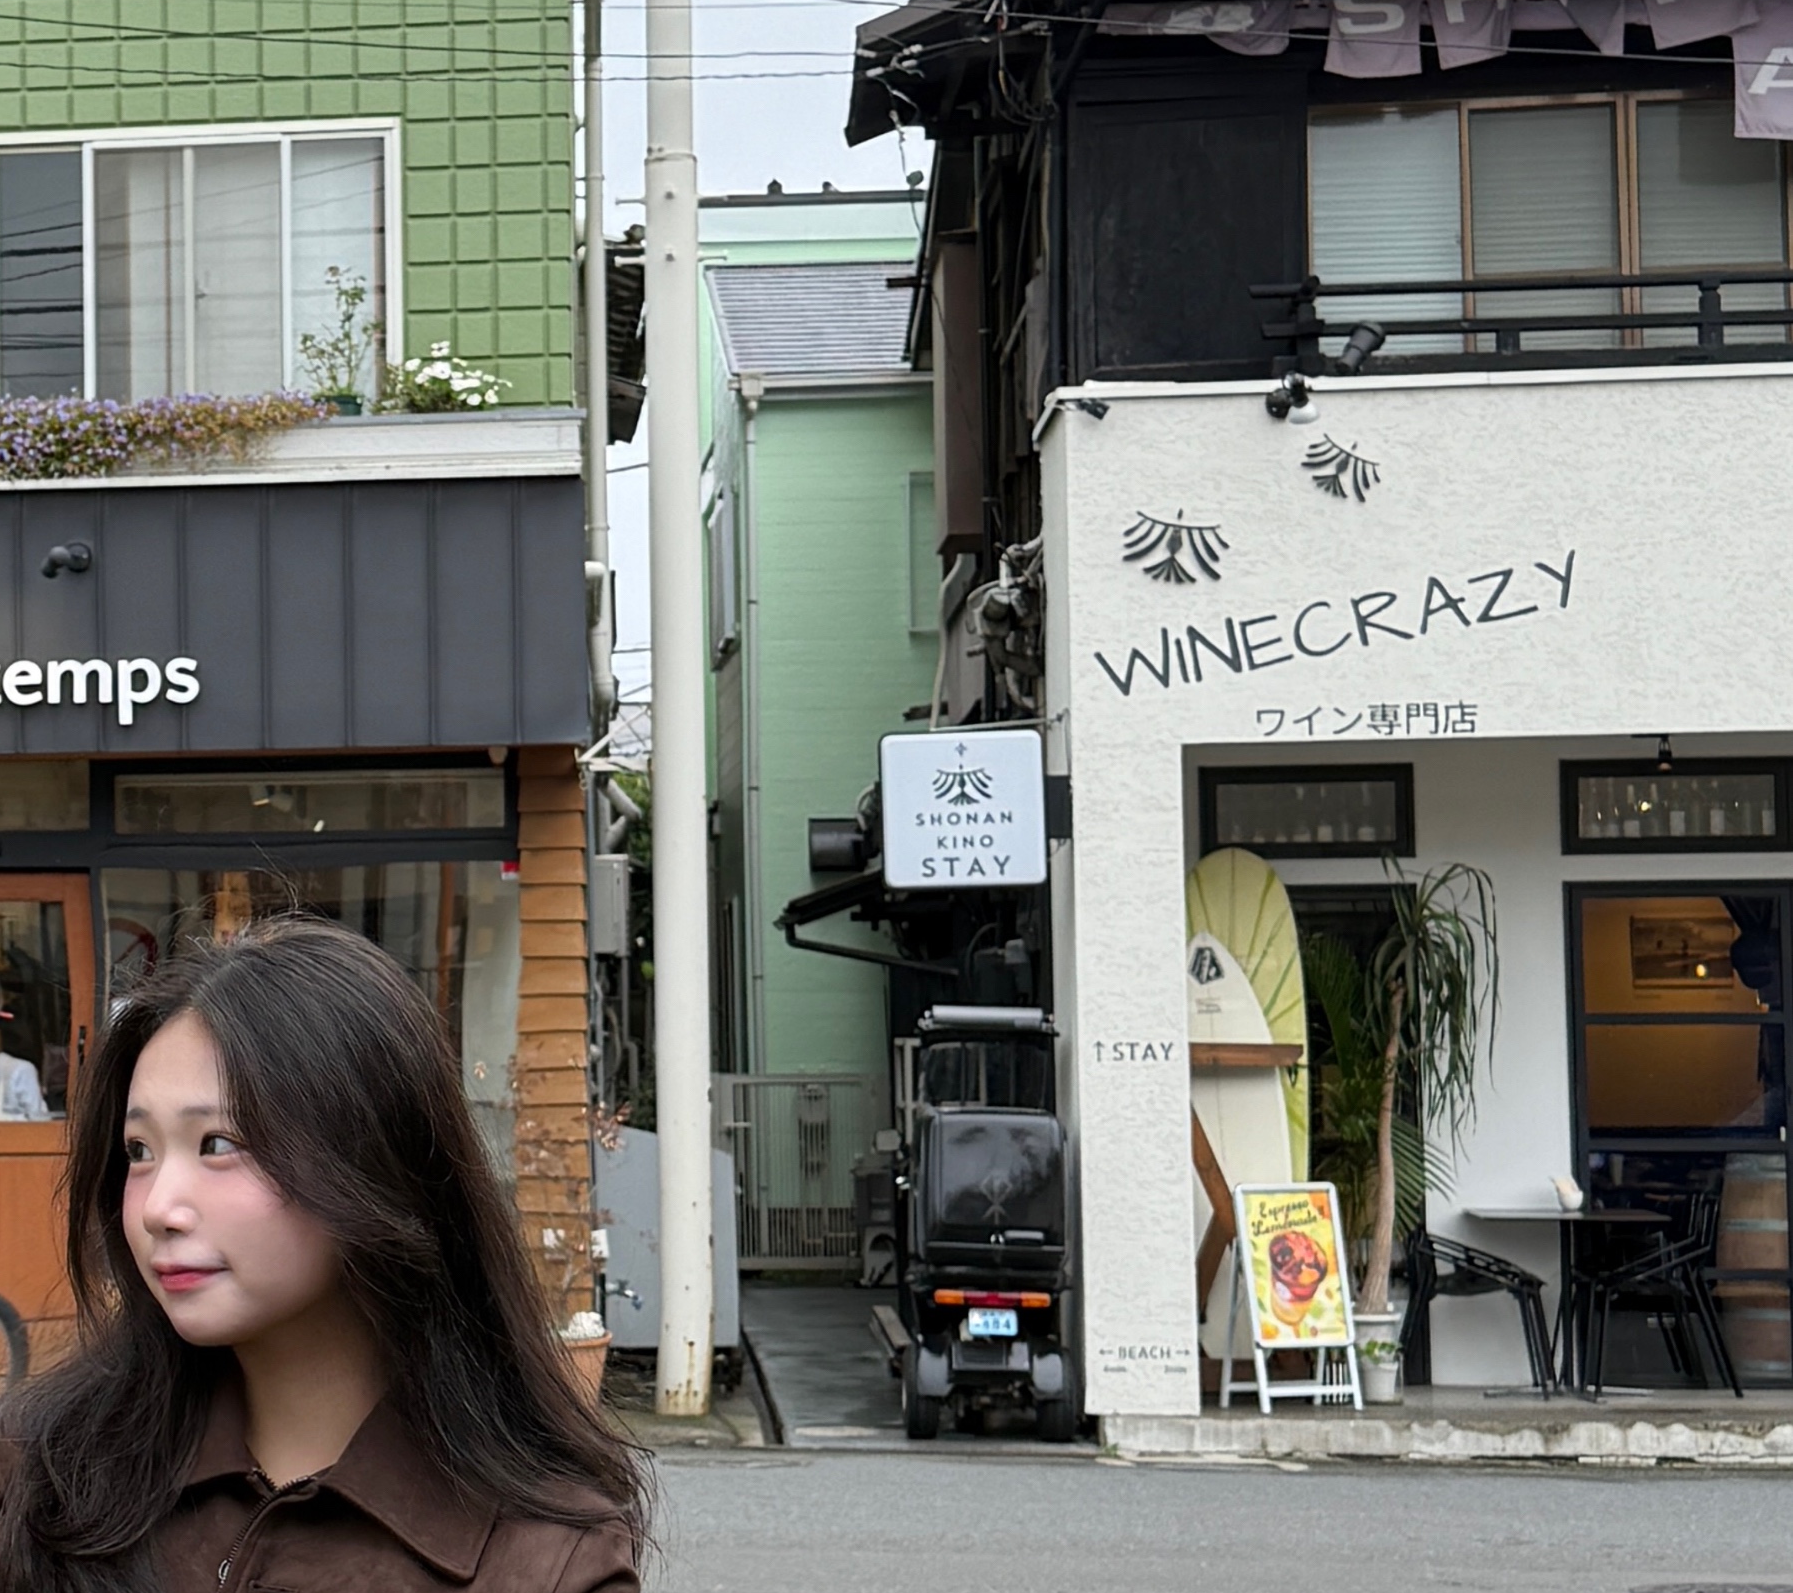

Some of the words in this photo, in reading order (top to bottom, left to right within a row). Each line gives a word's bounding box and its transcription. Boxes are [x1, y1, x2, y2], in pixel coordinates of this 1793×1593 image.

[1093, 549, 1577, 696] WINECRAZY
[1255, 700, 1478, 735] ワイン専門店
[915, 811, 1013, 827] SHONAN
[937, 834, 994, 849] KINO
[921, 855, 1011, 878] STAY
[1112, 1041, 1173, 1062] STAY
[1118, 1346, 1171, 1360] BEACH
